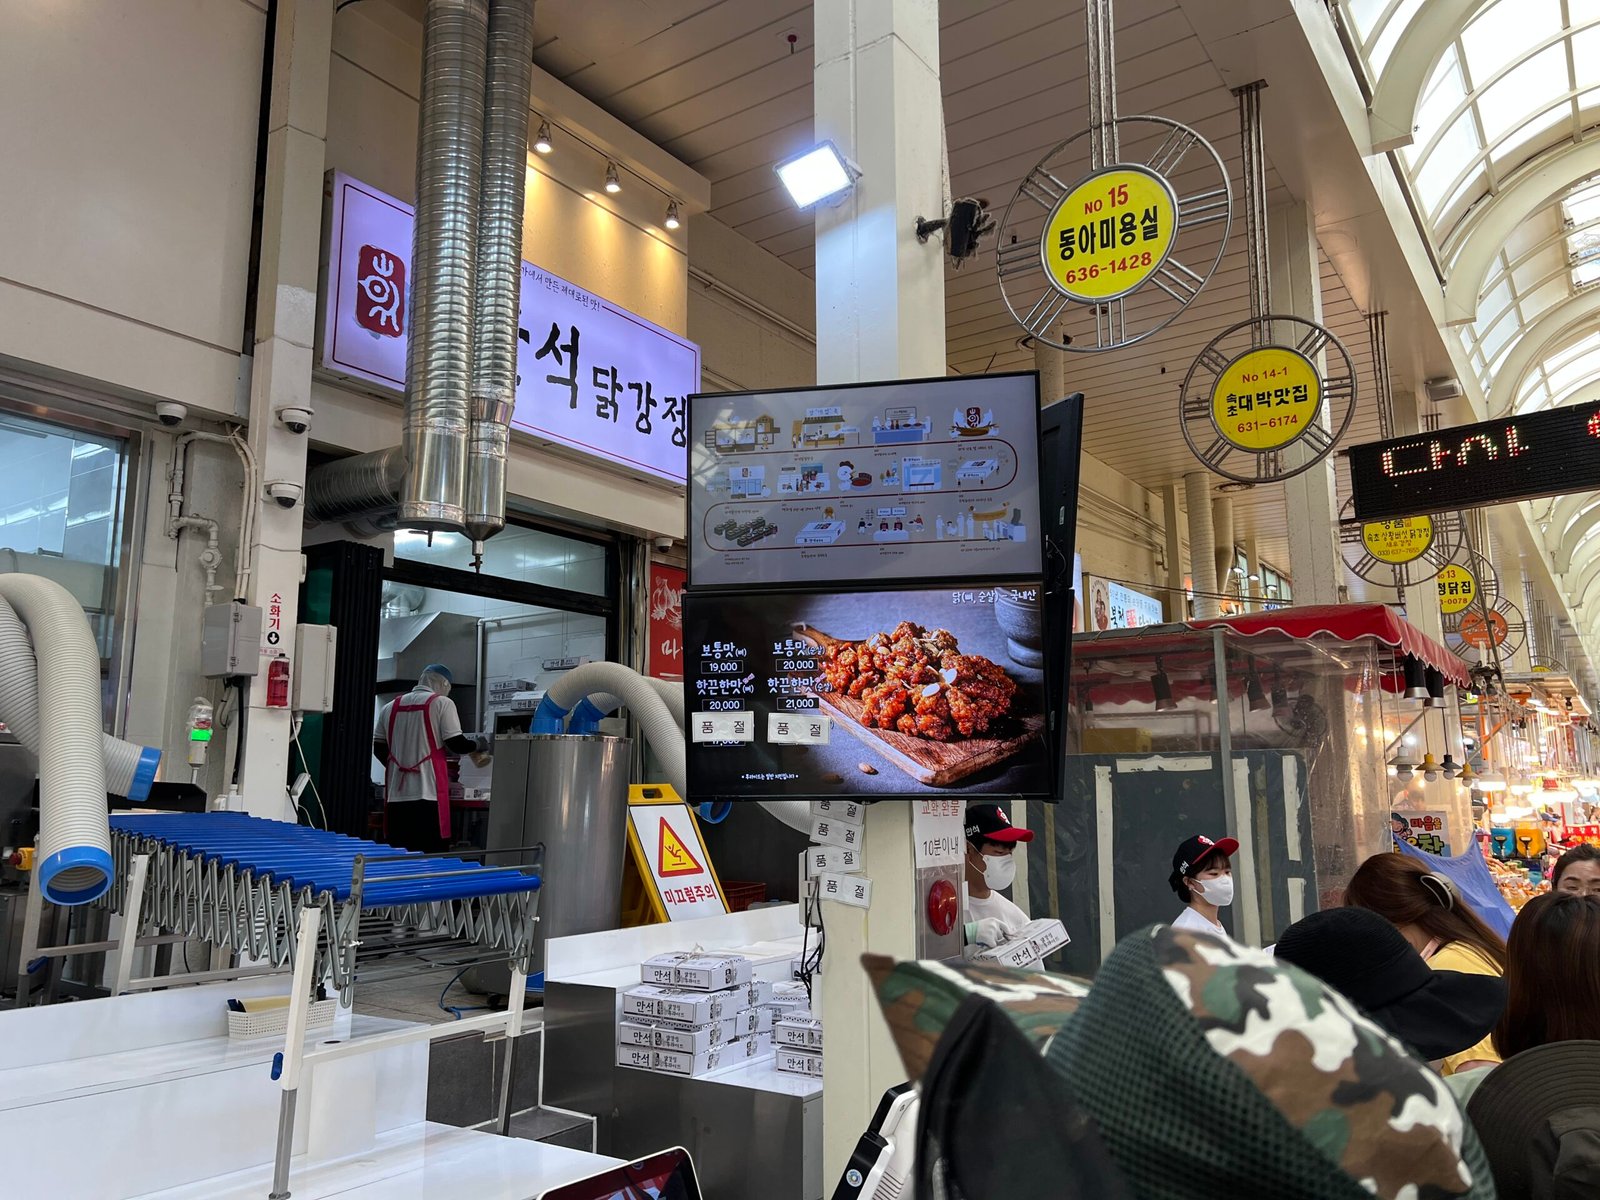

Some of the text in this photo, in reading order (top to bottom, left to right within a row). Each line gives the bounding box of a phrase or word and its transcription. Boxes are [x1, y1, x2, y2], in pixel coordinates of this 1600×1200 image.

[1084, 184, 1129, 215] NO 15
[1059, 205, 1159, 261] 동아미용실
[1066, 251, 1152, 284] 636-1428
[544, 277, 560, 294] 만든
[561, 285, 589, 307] 제대로된
[590, 299, 600, 312] 맛!
[1242, 366, 1289, 383] No 14-1
[592, 365, 687, 448] 닭강정
[1226, 384, 1308, 417] 속초 대박맛집
[1237, 414, 1298, 433] 631-6174
[1368, 533, 1380, 543] 속초
[1410, 528, 1430, 539] 닭강정
[1446, 569, 1456, 579] 13
[978, 590, 999, 603] 순살)
[1010, 589, 1036, 601] 국내산
[1438, 581, 1471, 596] 정닭집
[1440, 597, 1468, 605] -0078
[269, 593, 282, 630] 소화기
[709, 662, 738, 673] 19,000
[783, 660, 815, 671] 20,000
[709, 700, 740, 712] 20,000
[785, 699, 814, 711] 21,000
[1410, 815, 1442, 831] 마음을
[965, 825, 980, 837] 만석
[923, 836, 959, 857] 10분이내
[664, 883, 717, 905] 미끄럼주의
[1011, 947, 1032, 966] 만석
[654, 970, 671, 983] 만석
[636, 1000, 654, 1015] 만석
[787, 1031, 805, 1044] 만석
[631, 1052, 650, 1067] 만석
[787, 1058, 804, 1071] 만석
